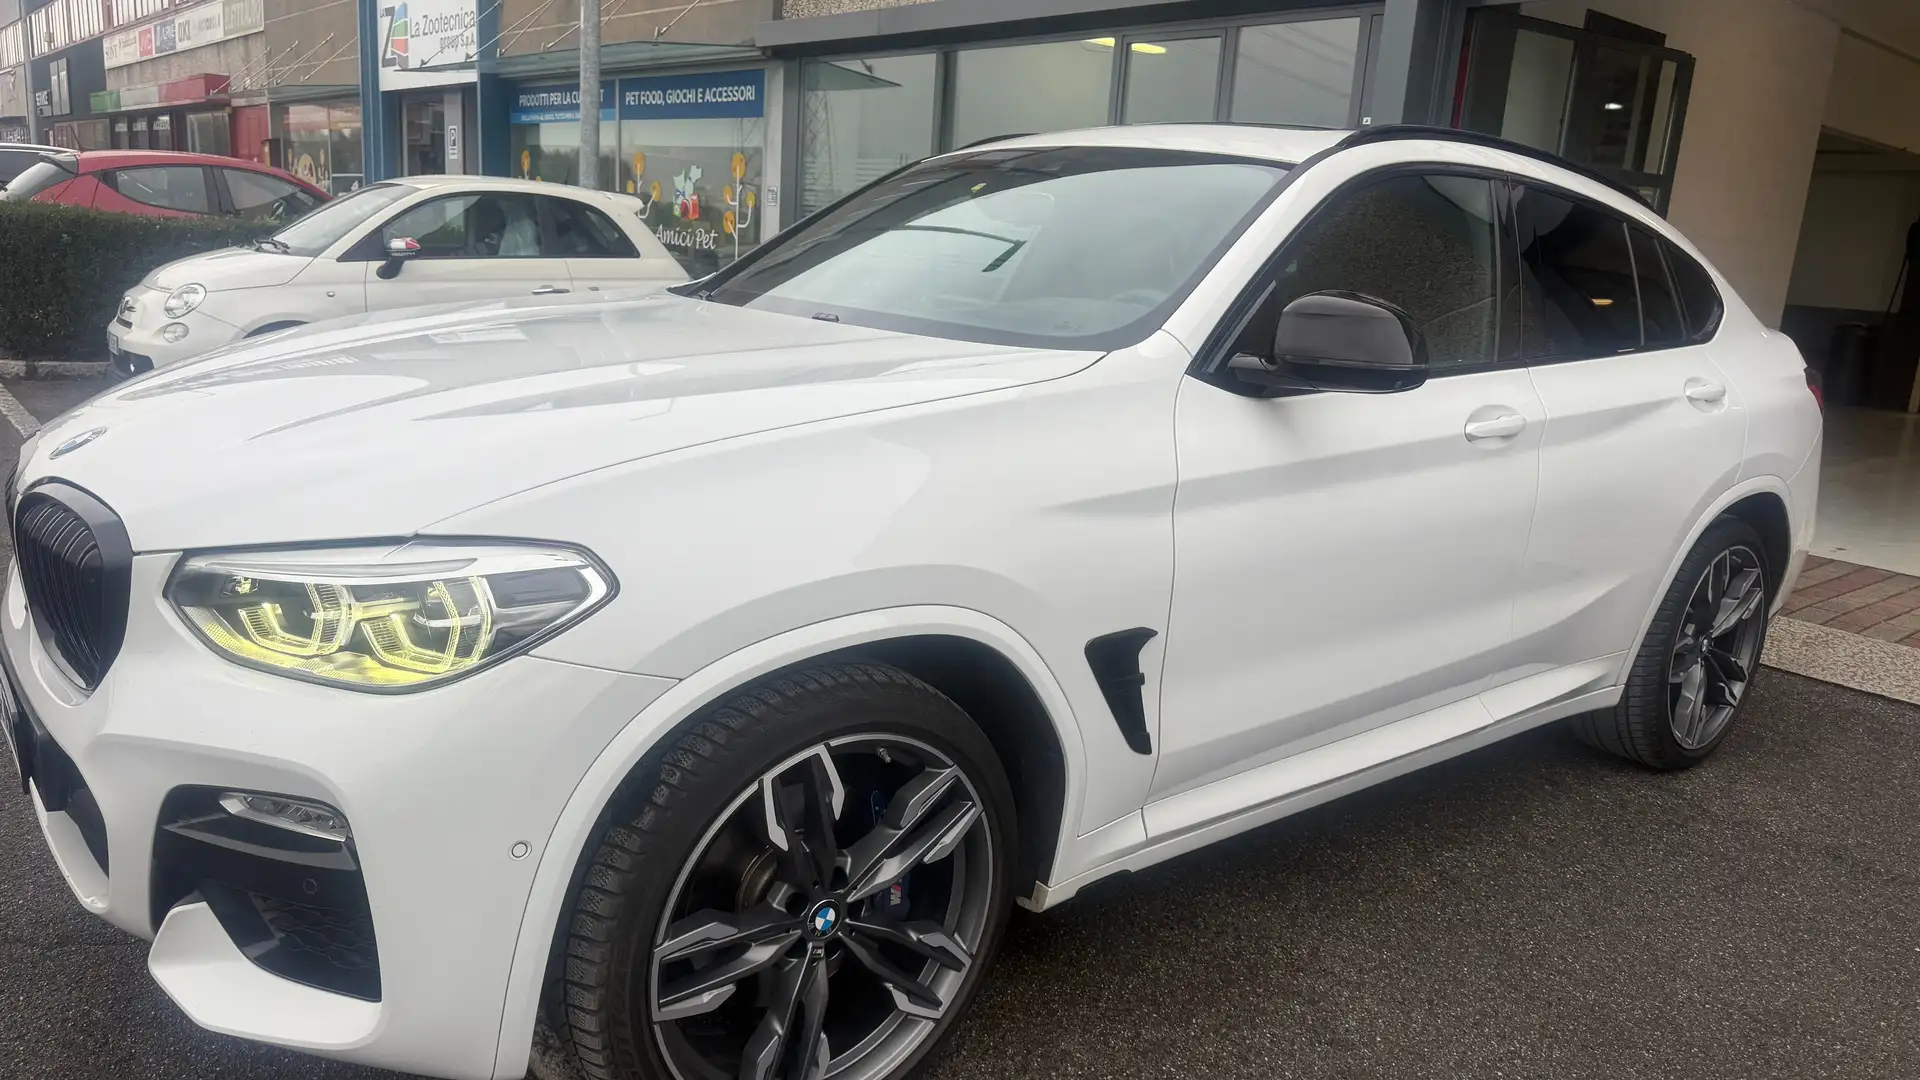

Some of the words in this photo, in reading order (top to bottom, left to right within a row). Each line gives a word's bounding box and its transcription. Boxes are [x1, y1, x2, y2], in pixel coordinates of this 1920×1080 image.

[410, 17, 420, 38] La
[422, 7, 475, 36] Zootecnica
[440, 35, 459, 54] group
[519, 93, 549, 107] PRODOTTI
[550, 92, 562, 105] PER
[562, 91, 572, 104] LA
[625, 91, 640, 106] PET
[640, 90, 665, 106] FOOD,
[665, 88, 696, 104] GIOCHI
[697, 88, 703, 103] E
[704, 85, 755, 102] ACCESSORI
[656, 224, 694, 247] Amici
[695, 228, 718, 249] Pet
